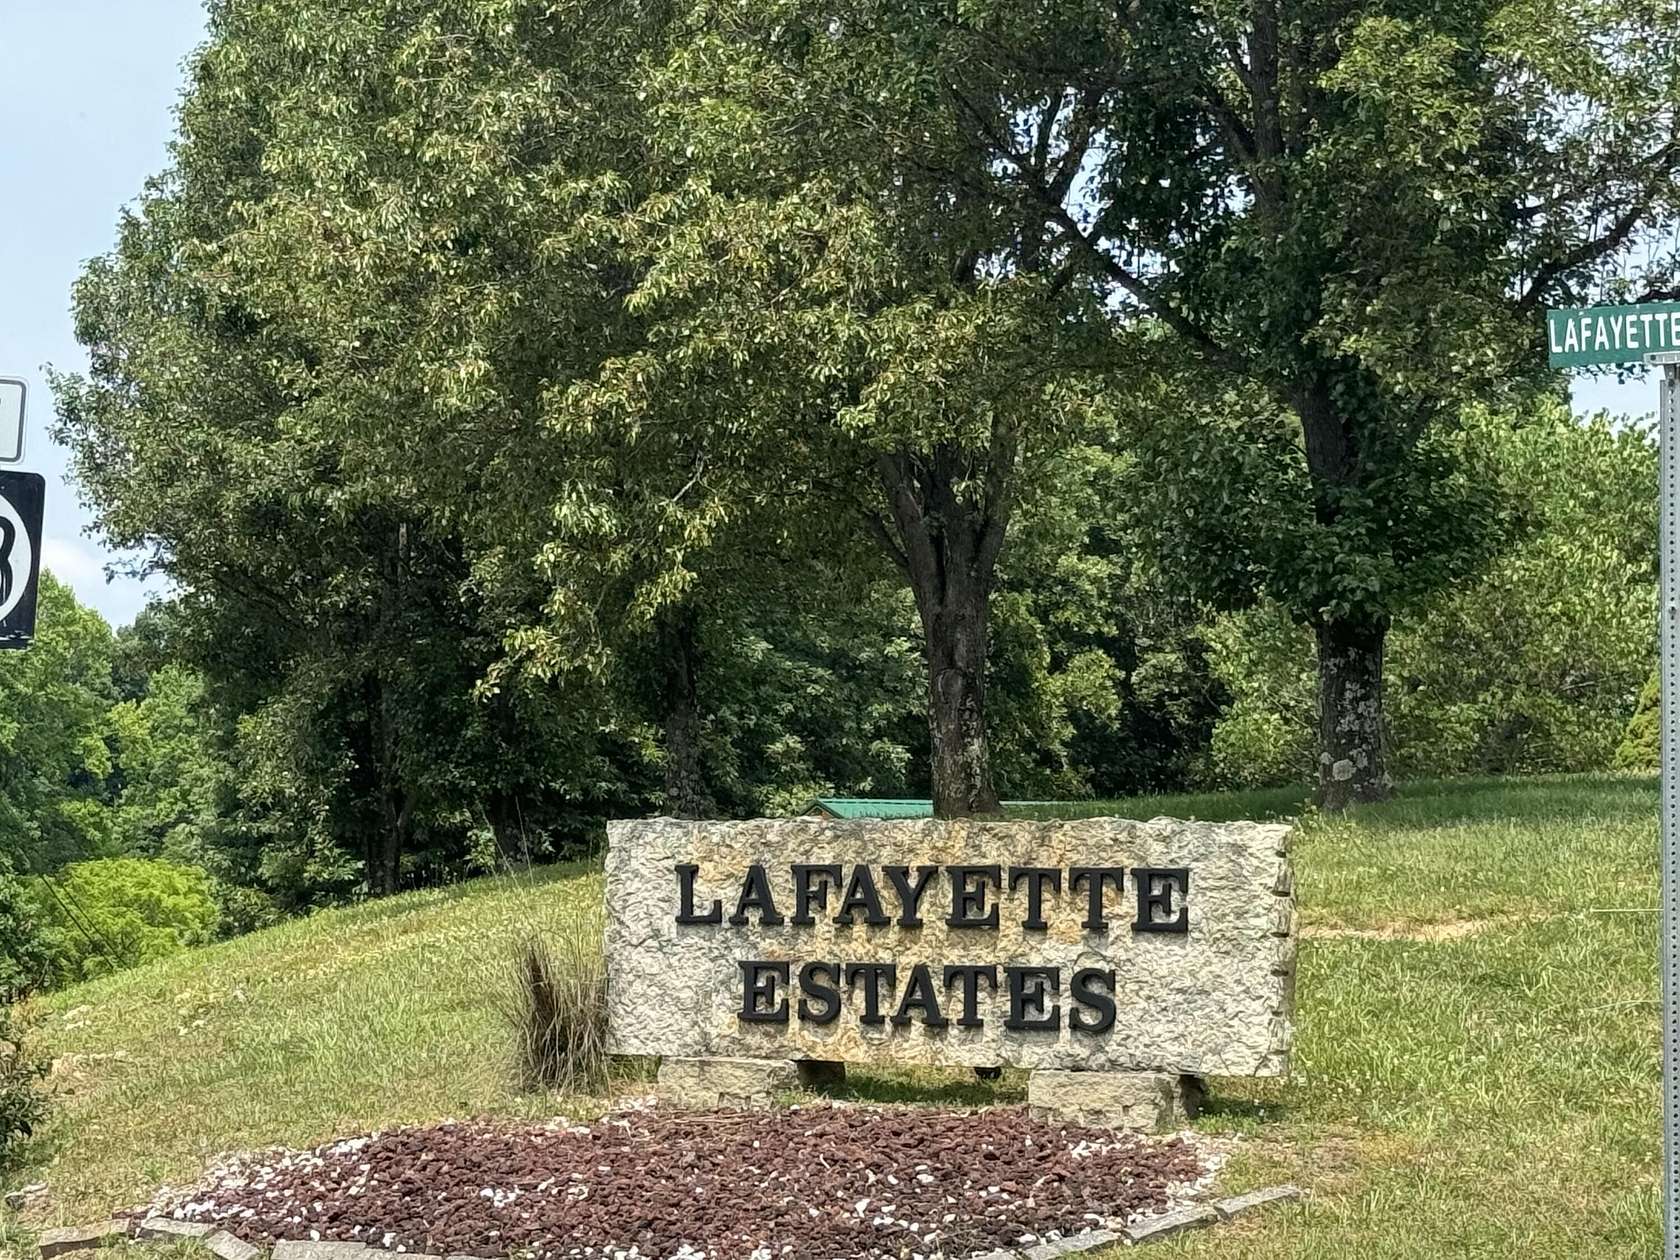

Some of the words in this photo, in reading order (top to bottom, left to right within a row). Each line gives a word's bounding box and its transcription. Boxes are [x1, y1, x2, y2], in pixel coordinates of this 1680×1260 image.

[1550, 312, 1680, 353] LAFAYETTE
[675, 864, 1189, 932] LAFAYETTE
[738, 961, 1116, 1032] ESTATES
